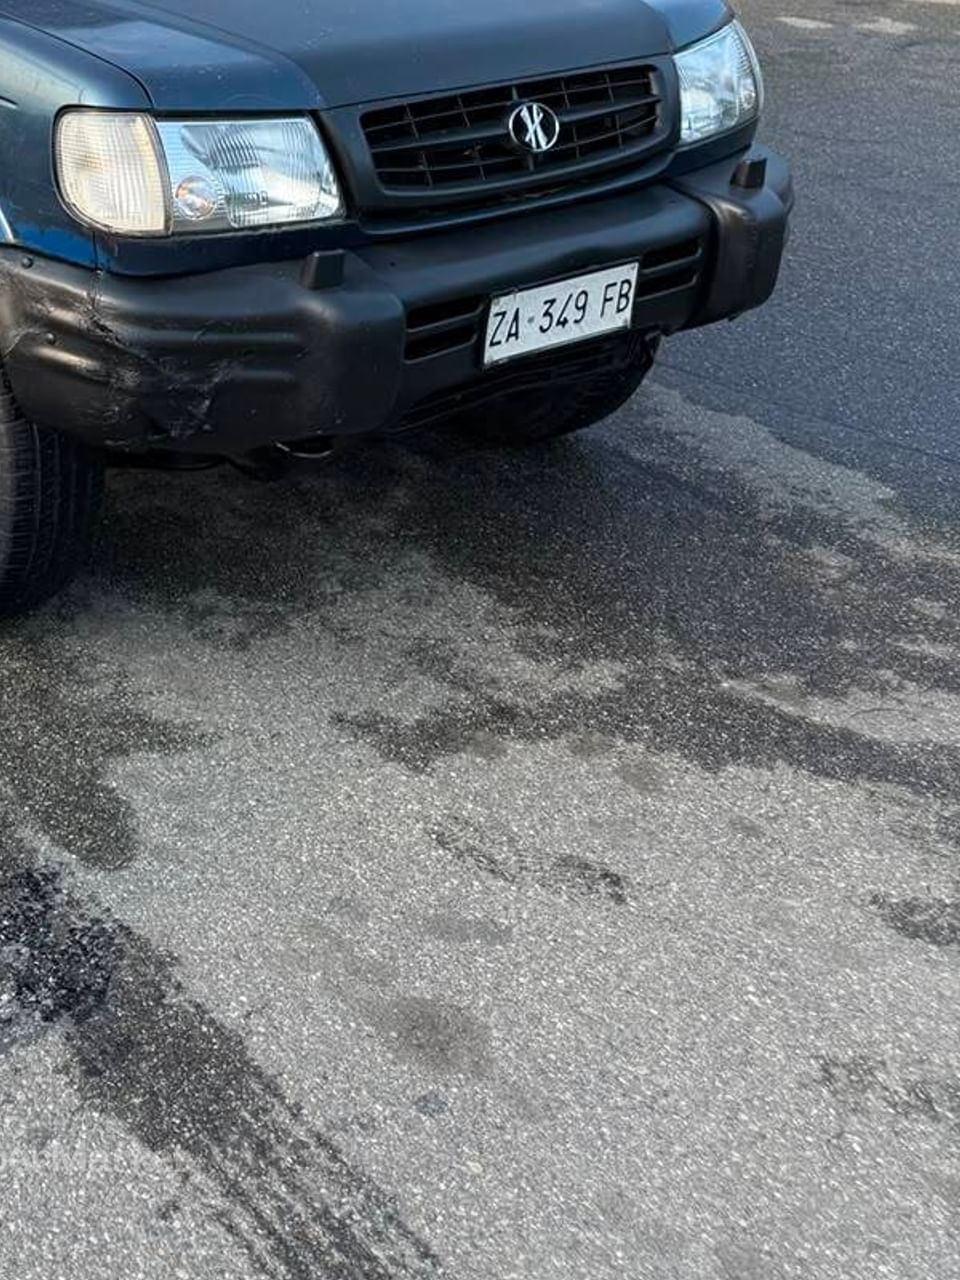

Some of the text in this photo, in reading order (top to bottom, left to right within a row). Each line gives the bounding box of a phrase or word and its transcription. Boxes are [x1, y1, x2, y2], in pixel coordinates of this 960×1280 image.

[489, 278, 633, 348] ZA 349 FB
